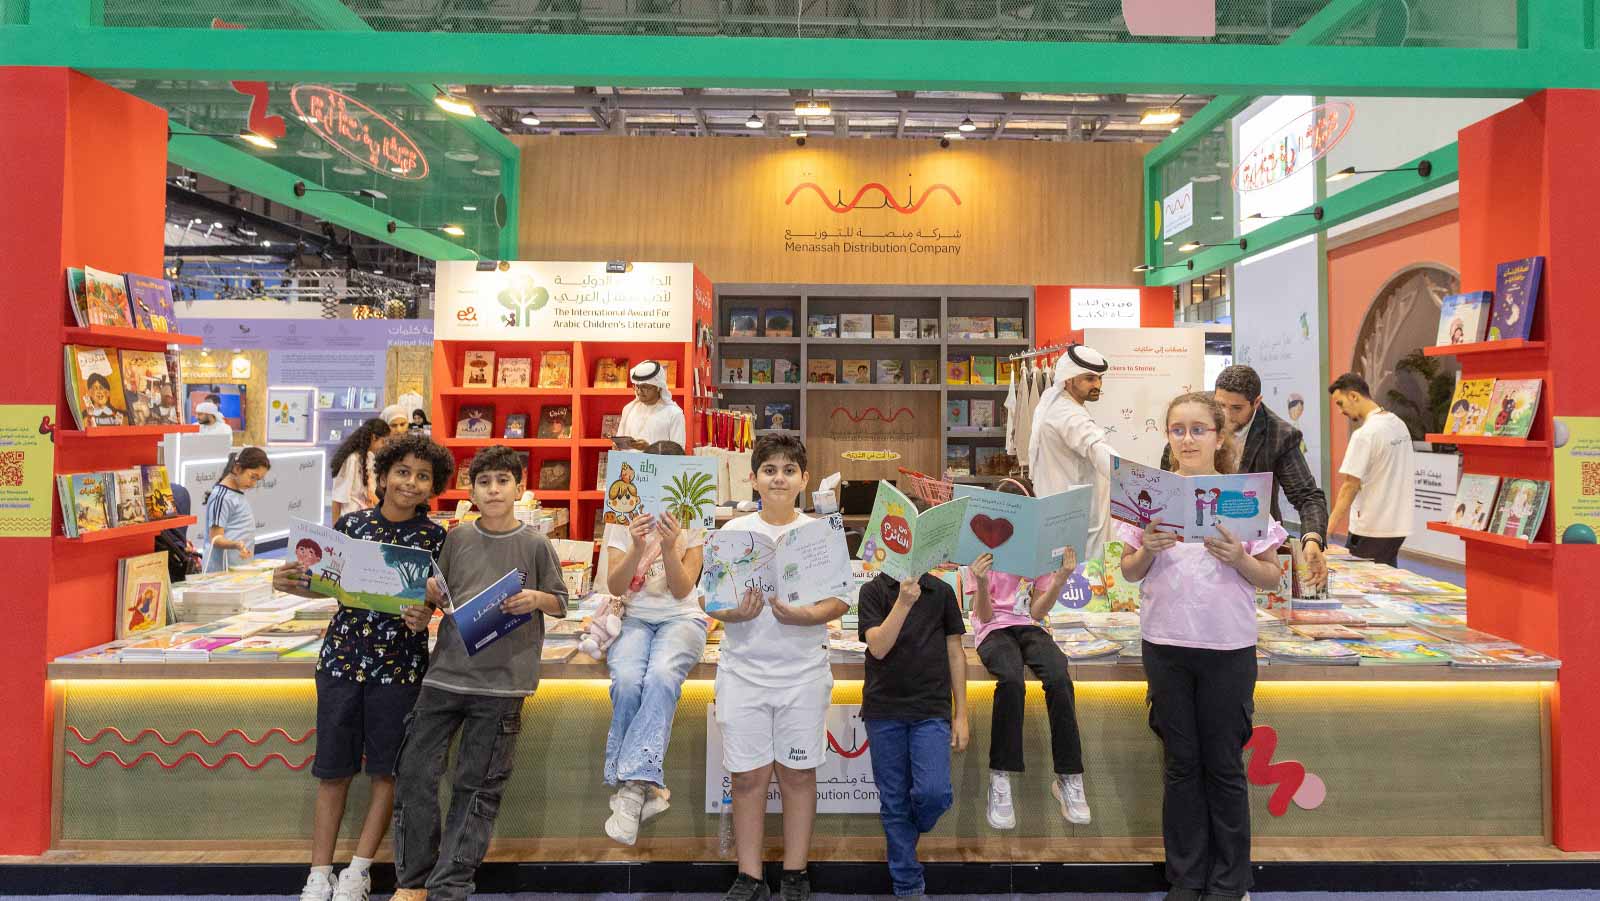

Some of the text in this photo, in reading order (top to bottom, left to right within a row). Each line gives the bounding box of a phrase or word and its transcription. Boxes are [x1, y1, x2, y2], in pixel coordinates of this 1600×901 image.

[784, 226, 853, 241] للتوزيع
[916, 228, 962, 241] شركة
[785, 241, 961, 255] Menassah Distribution Company
[553, 290, 599, 304] العربي
[555, 307, 671, 317] The International Award For
[553, 319, 671, 329] Arabic Children's Literature
[640, 459, 657, 476] رحلة
[898, 524, 908, 535] من
[790, 746, 806, 754] Palm
